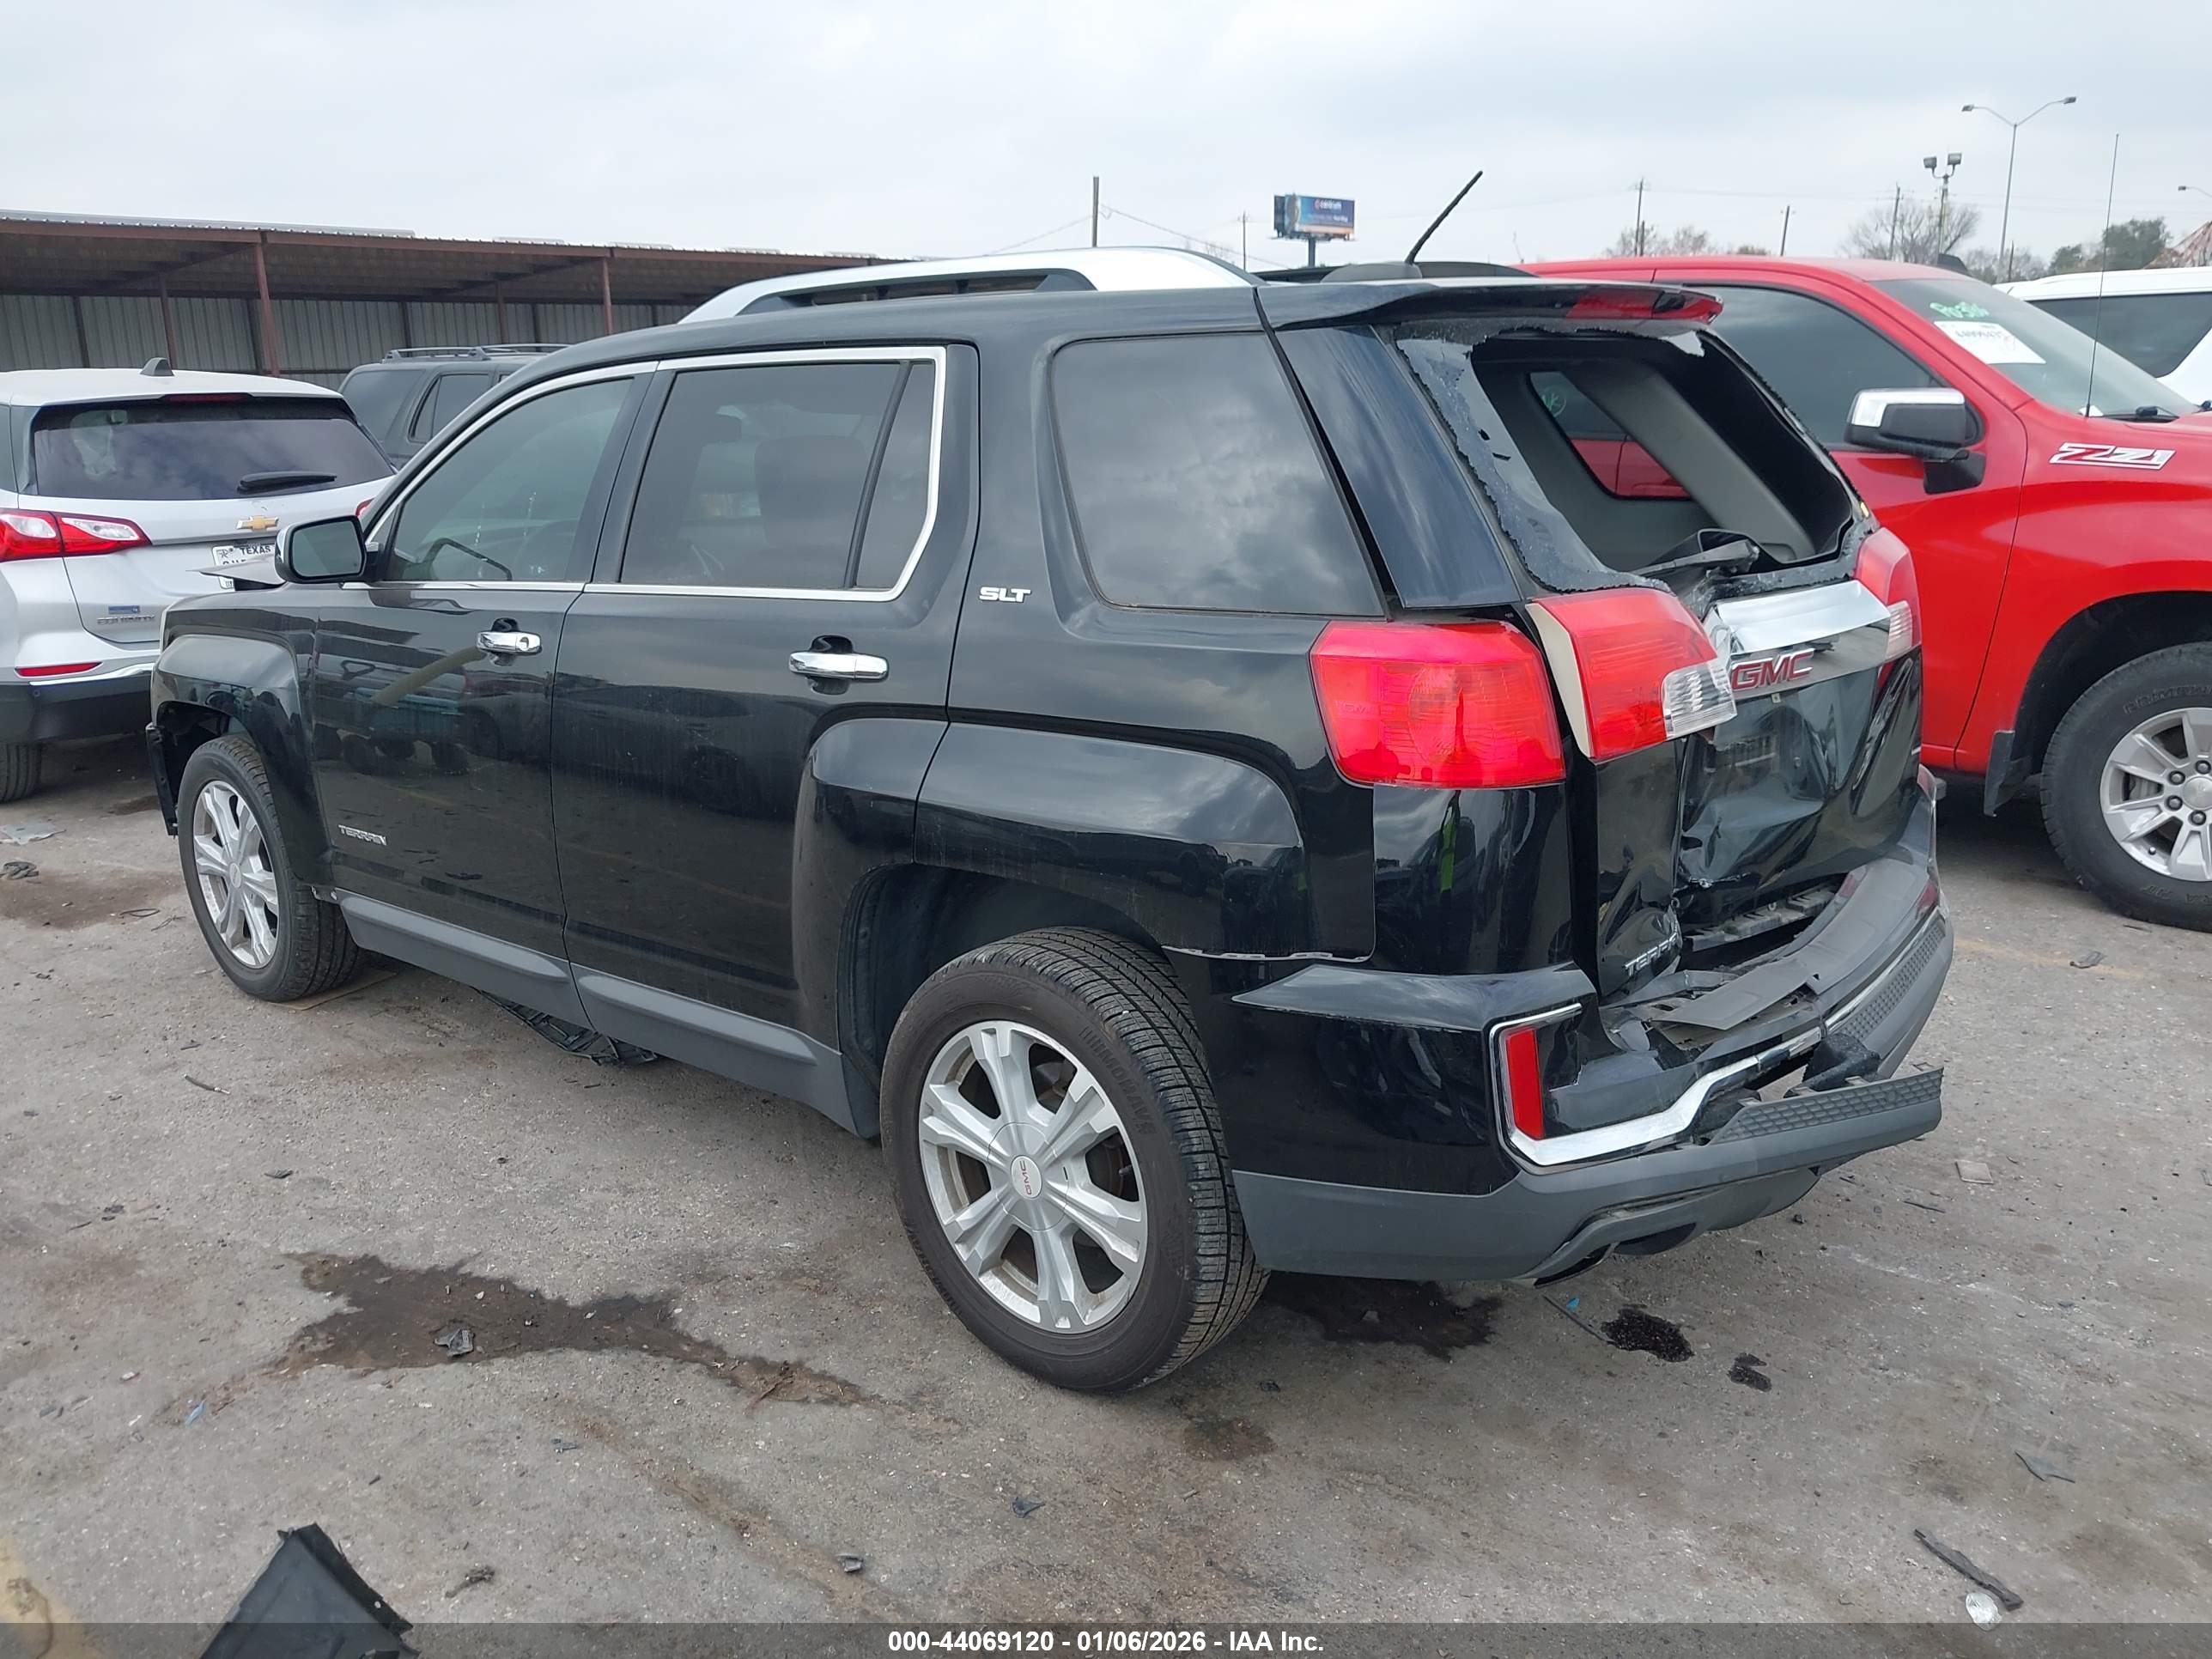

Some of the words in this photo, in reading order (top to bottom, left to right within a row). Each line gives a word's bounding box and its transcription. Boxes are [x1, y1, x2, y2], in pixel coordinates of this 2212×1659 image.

[240, 545, 271, 556] TEXAS
[979, 586, 1030, 603] SLT
[1731, 647, 1814, 691] GMC
[1019, 1160, 1032, 1195] GMC
